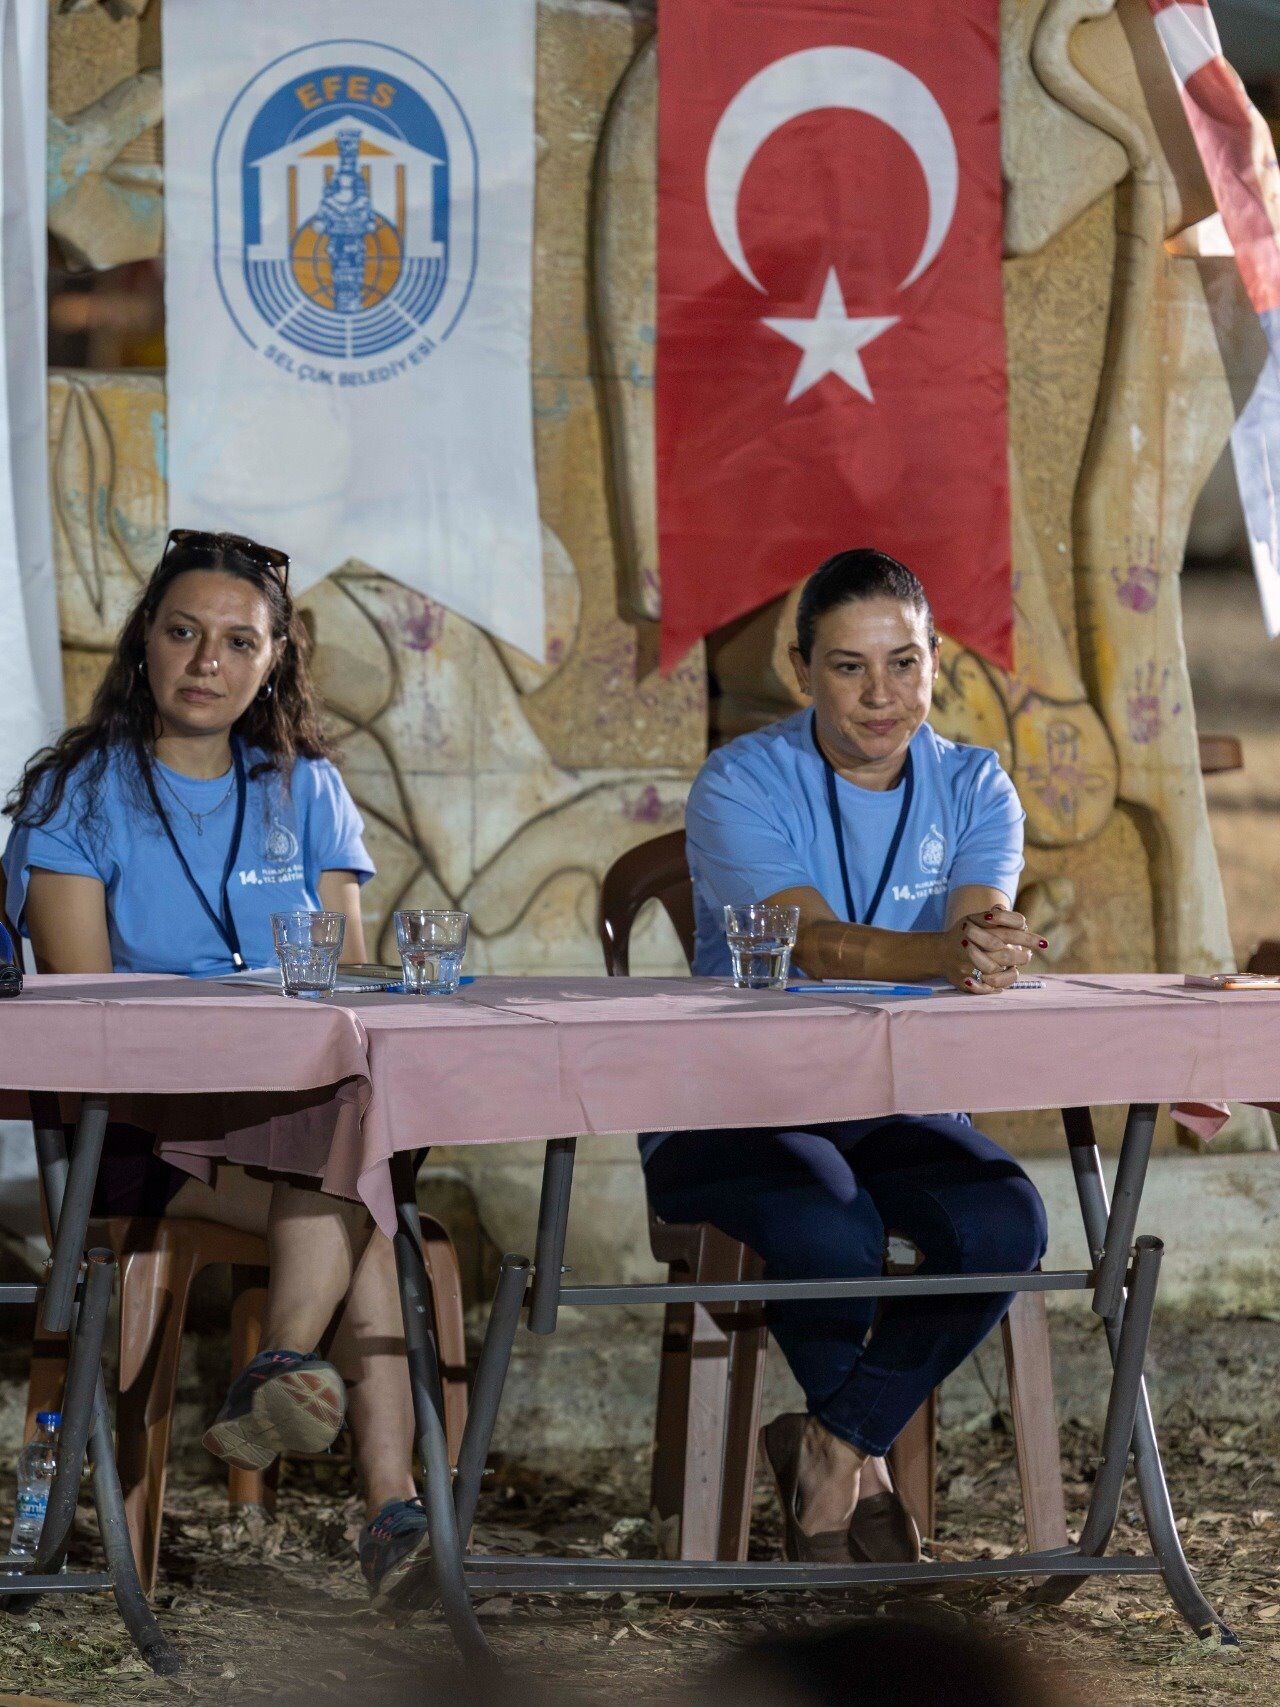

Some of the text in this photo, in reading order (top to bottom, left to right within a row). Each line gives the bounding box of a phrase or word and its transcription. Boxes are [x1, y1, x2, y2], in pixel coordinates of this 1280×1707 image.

[295, 75, 398, 110] EFES
[239, 869, 263, 885] 14.
[892, 885, 916, 900] 14.
